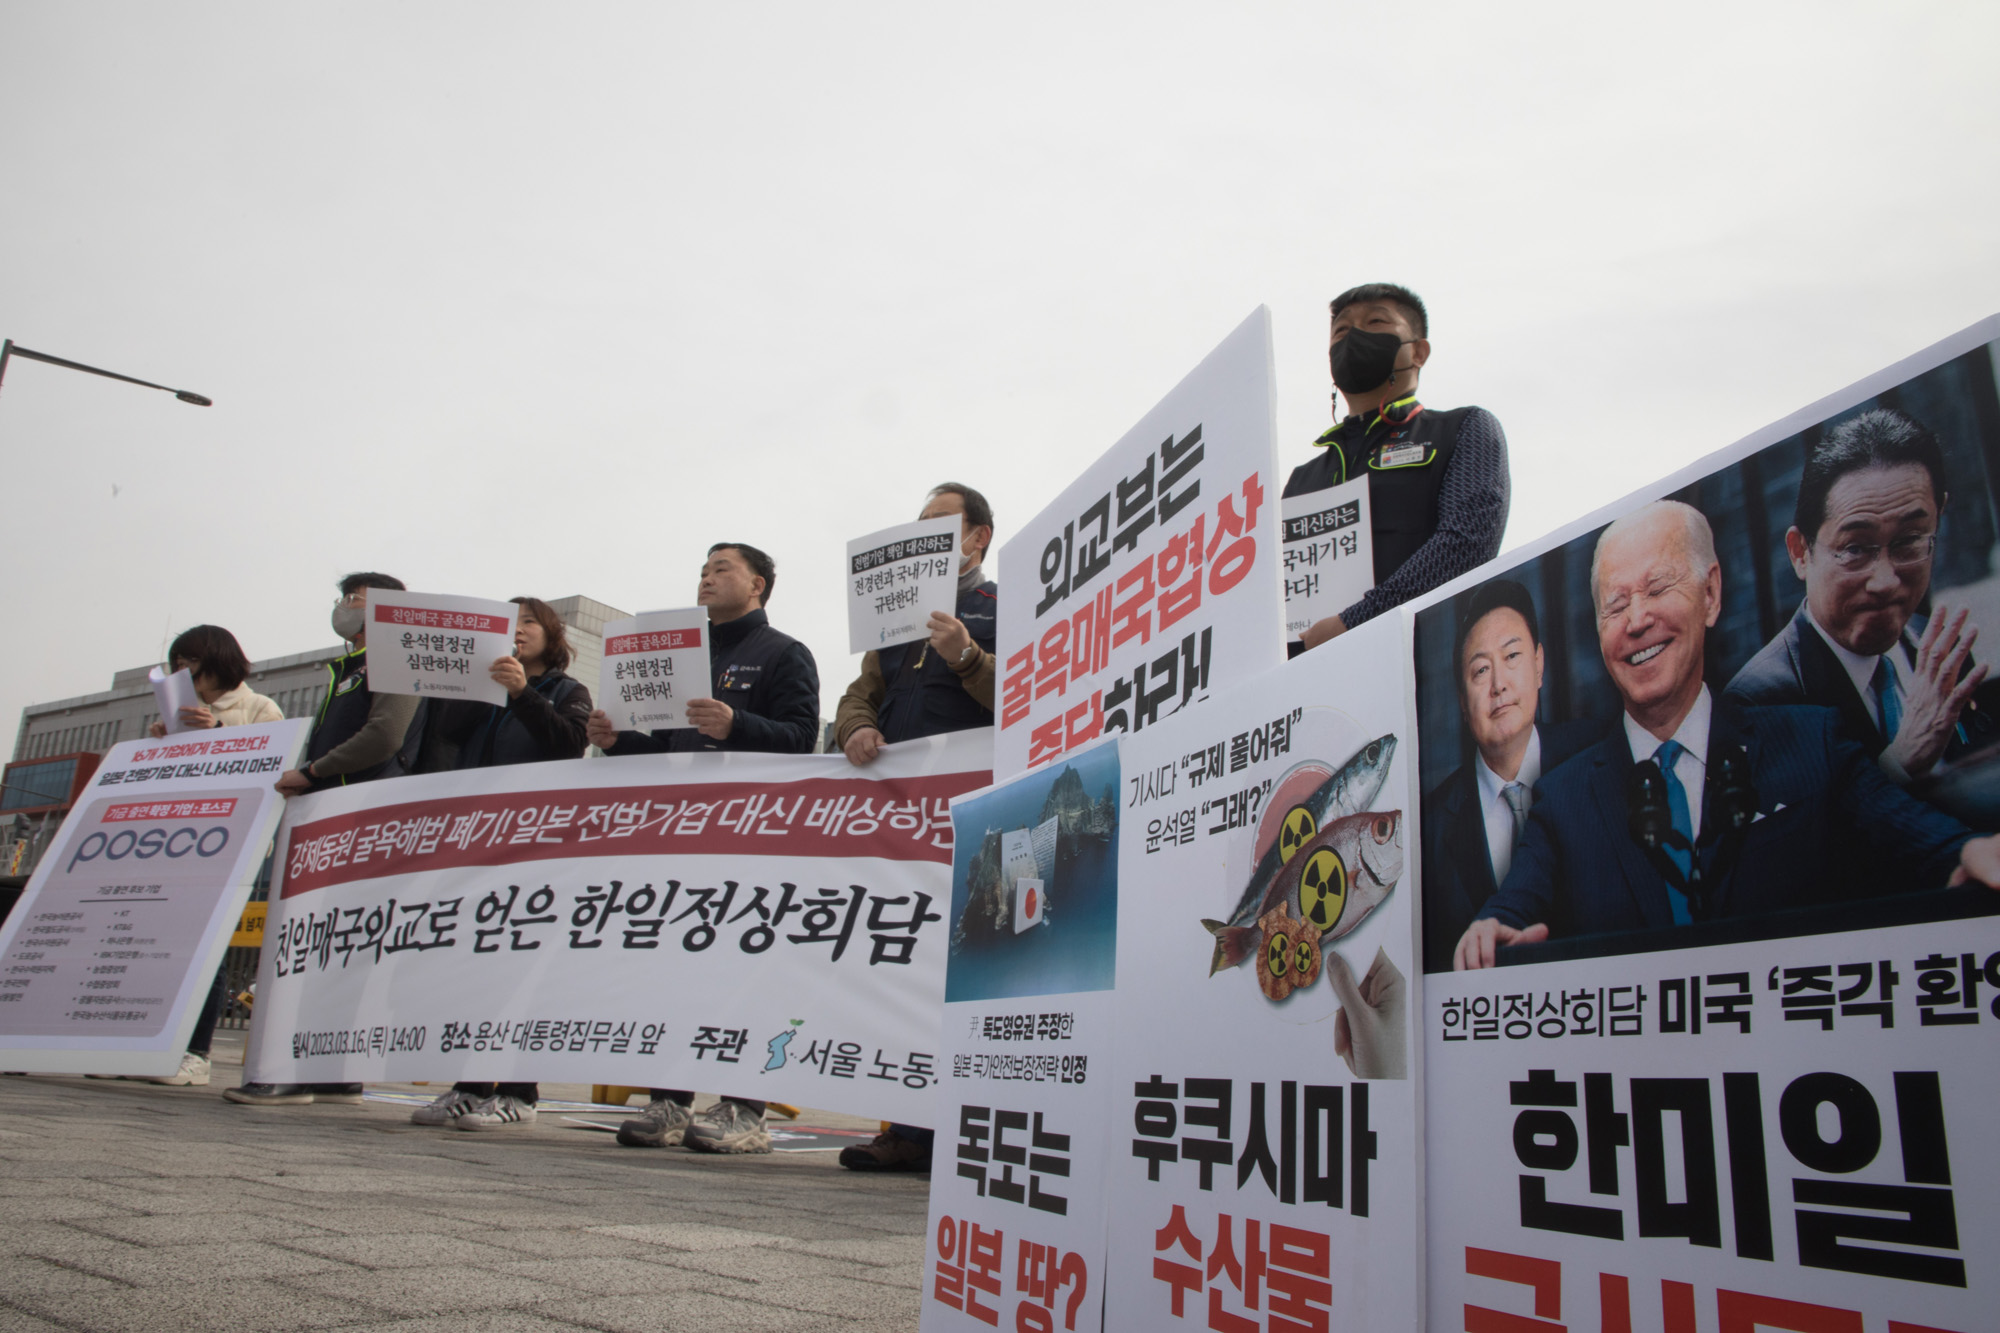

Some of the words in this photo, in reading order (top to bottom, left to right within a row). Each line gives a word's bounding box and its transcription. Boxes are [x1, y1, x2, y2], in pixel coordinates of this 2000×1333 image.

[1035, 422, 1205, 620] 외교부는
[1291, 507, 1357, 536] 대신하는
[854, 547, 885, 571] 전범기업
[887, 542, 904, 560] 책임
[906, 536, 951, 555] 대신하는
[1283, 530, 1357, 572] 국내기업
[854, 568, 895, 597] 전경련과
[896, 557, 949, 583] 국내기업
[392, 608, 439, 626] 친일매국
[441, 613, 491, 630] 굴욕외교
[875, 586, 919, 615] 규탄한다!
[1001, 470, 1264, 731] 굴욕매국협상
[400, 632, 475, 655] 윤석열정권
[641, 633, 684, 648] 굴욕외교
[406, 653, 470, 675] 심판하자!
[614, 657, 674, 679] 윤석열정권
[620, 682, 673, 703] 심판하자!
[131, 749, 156, 762] 16개
[157, 742, 211, 759] 기업에게
[210, 735, 270, 755] 경고한다!
[98, 771, 126, 786] 일본
[124, 764, 176, 783] 전범기업
[174, 761, 204, 778] 대신
[204, 759, 248, 777] 나서지
[248, 756, 283, 772] 마라!
[1129, 761, 1177, 808] 기시다
[107, 808, 128, 820] 기금
[128, 806, 146, 818] 출연
[149, 805, 170, 817] 확정
[198, 802, 232, 815] 포스코
[290, 827, 359, 879] 강제동원
[352, 813, 451, 864] 굴욕해법
[445, 808, 511, 850] 폐기!
[508, 804, 579, 845] 일본
[577, 800, 723, 842] 전범기업
[717, 793, 805, 835] 대신
[804, 795, 953, 849] 배상하는
[1146, 806, 1196, 854] 윤석열
[67, 826, 229, 873] posco
[274, 897, 465, 978] 친일매국외교로
[473, 884, 558, 953] 얻은
[569, 879, 942, 966] 한일정상회담
[1441, 984, 1647, 1041] 한일정상회담
[1659, 971, 1753, 1034] 미국
[389, 1026, 426, 1052] 14:00
[440, 1021, 472, 1053] 장소
[511, 1019, 637, 1053] 대통령집무실
[637, 1022, 666, 1055] 앞
[690, 1026, 748, 1063] 주관
[983, 1014, 1035, 1041] 독도영유권
[1037, 1012, 1074, 1041] 주장한
[799, 1039, 862, 1078] 서울
[867, 1049, 940, 1089] 노동
[953, 1053, 972, 1078] 일본
[973, 1054, 1059, 1083] 국가안전보장전략
[1061, 1055, 1087, 1084] 인정
[957, 1104, 1071, 1217] 독도는
[1132, 1074, 1377, 1218] 후쿠시마
[1509, 1069, 1968, 1288] 한미일
[934, 1215, 1003, 1328] 일본
[1015, 1238, 1087, 1333] 땅?
[1153, 1204, 1333, 1333] 수산물
